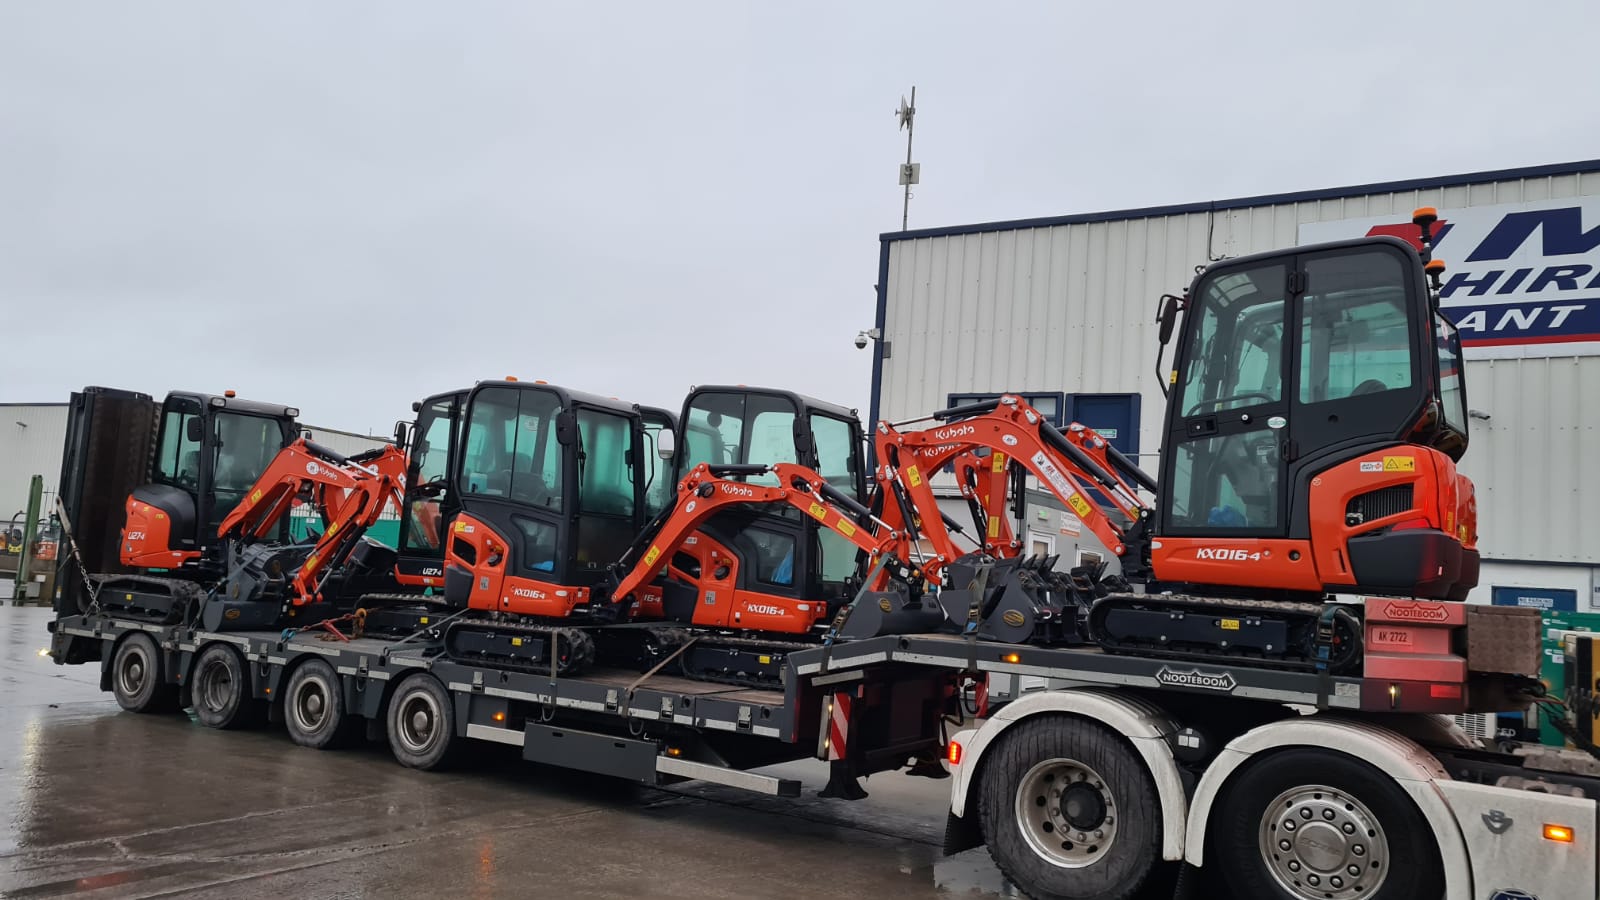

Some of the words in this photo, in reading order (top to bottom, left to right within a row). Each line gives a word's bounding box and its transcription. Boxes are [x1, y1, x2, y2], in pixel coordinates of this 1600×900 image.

[1455, 304, 1587, 332] ANT
[935, 424, 975, 440] Kubota
[924, 443, 962, 457] Kub
[721, 483, 753, 497] Kubota
[1196, 547, 1261, 561] KX016-4
[643, 594, 661, 603] 16-4
[1389, 608, 1444, 619] NOOTEBOOM
[1378, 631, 1387, 642] AK
[1389, 631, 1408, 643] 2722
[1162, 673, 1229, 688] NOOTEBOOM
